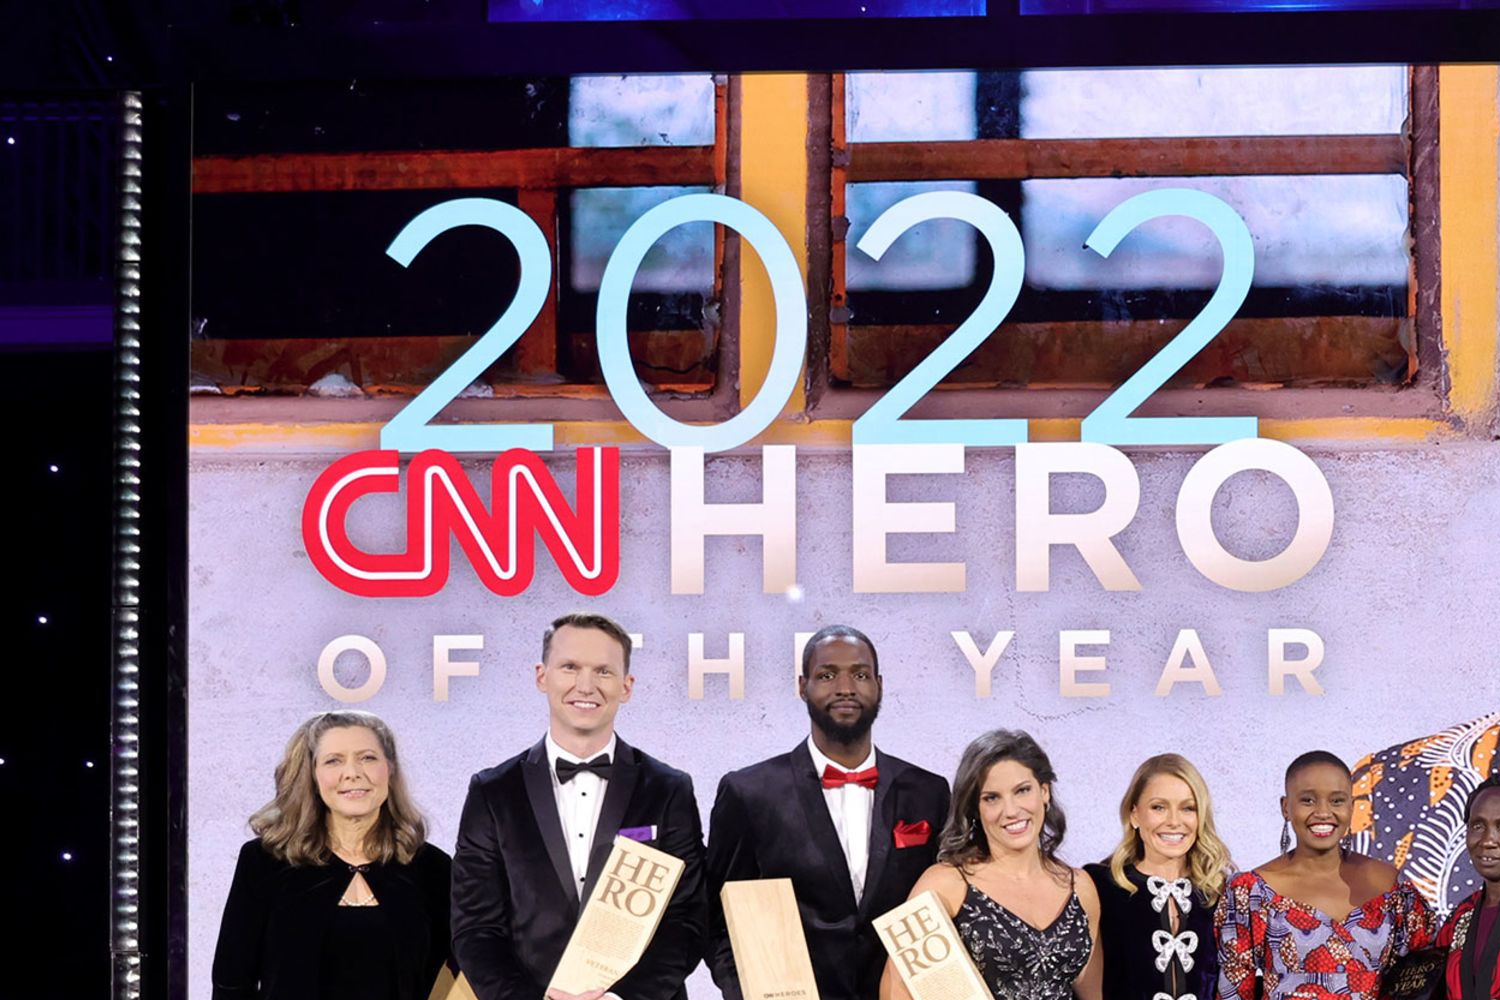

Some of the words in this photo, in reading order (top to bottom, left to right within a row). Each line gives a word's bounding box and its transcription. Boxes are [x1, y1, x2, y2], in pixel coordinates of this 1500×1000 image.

[380, 187, 1258, 453] 2022
[302, 447, 619, 597] CNN
[670, 437, 1334, 595] HERO
[317, 634, 484, 702] OF
[950, 628, 1325, 698] YEAR
[610, 849, 669, 893] HE
[598, 875, 656, 917] RO
[884, 905, 940, 952] HE
[897, 933, 951, 979] RO
